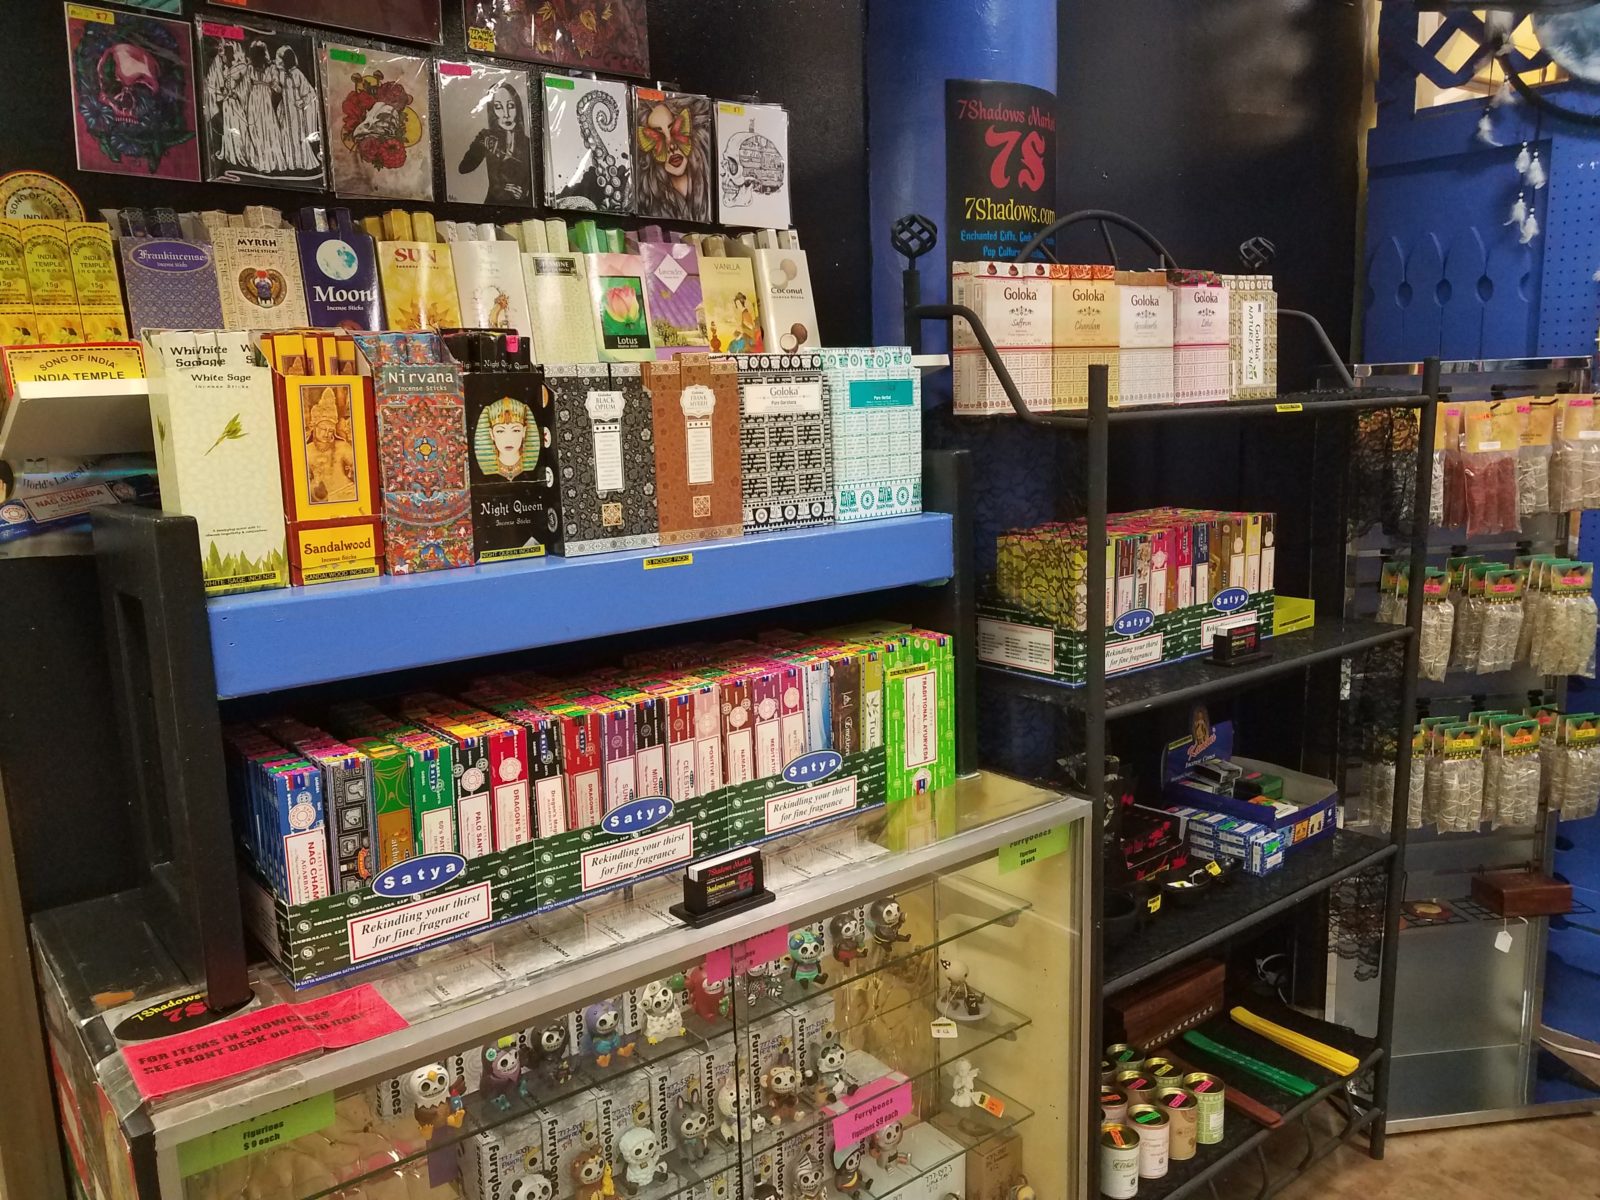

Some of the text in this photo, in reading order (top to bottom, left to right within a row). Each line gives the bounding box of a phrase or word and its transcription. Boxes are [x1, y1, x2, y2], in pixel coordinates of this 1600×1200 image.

[958, 99, 1025, 124] 7Shadows
[984, 124, 1046, 192] 7S
[965, 197, 1056, 225] 7Shadows.com
[237, 238, 277, 247] MYRRH
[961, 231, 997, 241] Enchanted
[313, 286, 374, 302] Moon
[771, 287, 803, 295] Coconut
[1003, 287, 1037, 301] Goloka
[1072, 288, 1105, 302] Goloka
[1131, 294, 1159, 307] Goloka
[1194, 291, 1218, 304] Goloka
[617, 336, 638, 345] Lotus
[40, 357, 68, 372] SONG
[71, 354, 85, 362] OF
[87, 355, 116, 368] INDIA
[34, 370, 125, 382] INDIA TEMPLE
[191, 373, 252, 382] White Sage
[389, 369, 454, 384] Nirvana
[770, 386, 799, 397] Goloka
[36, 497, 58, 508] NAG
[60, 489, 104, 503] CHAMPA
[480, 499, 544, 517] Night Queen
[304, 538, 371, 556] Sandalwood
[304, 571, 349, 581] SANDALWOOD
[1216, 593, 1246, 606] Satya
[1118, 615, 1151, 630] Satya
[868, 720, 876, 749] TULS
[789, 758, 836, 777] Satya
[773, 784, 850, 813] Rekindling your thirst
[610, 805, 667, 828] Satya
[780, 797, 843, 824] for fine fragrance
[591, 832, 685, 867] Rekindling your thirst
[308, 841, 320, 900] NAG CHAM
[383, 861, 457, 889] Satya
[600, 848, 677, 879] for fine fragrance
[301, 859, 310, 899] AGARBATT
[361, 892, 481, 935] Rekindling your thirst
[373, 910, 470, 949] for fine fragrance
[131, 993, 202, 1022] 7Shadows
[138, 1051, 170, 1066] FOR
[172, 1037, 220, 1057] ITEMS
[222, 1032, 239, 1043] IN
[143, 1062, 172, 1075] SEE
[175, 1048, 224, 1067] FRONT
[227, 1034, 267, 1053] DESK
[751, 1033, 762, 1105] Furrybones
[704, 1054, 716, 1128] Furrybones
[658, 1075, 669, 1151] Furrybones
[854, 1097, 894, 1122] Furrybones
[258, 1133, 281, 1146] each
[601, 1099, 614, 1166] Furrybone
[488, 1144, 501, 1200] Furrybo
